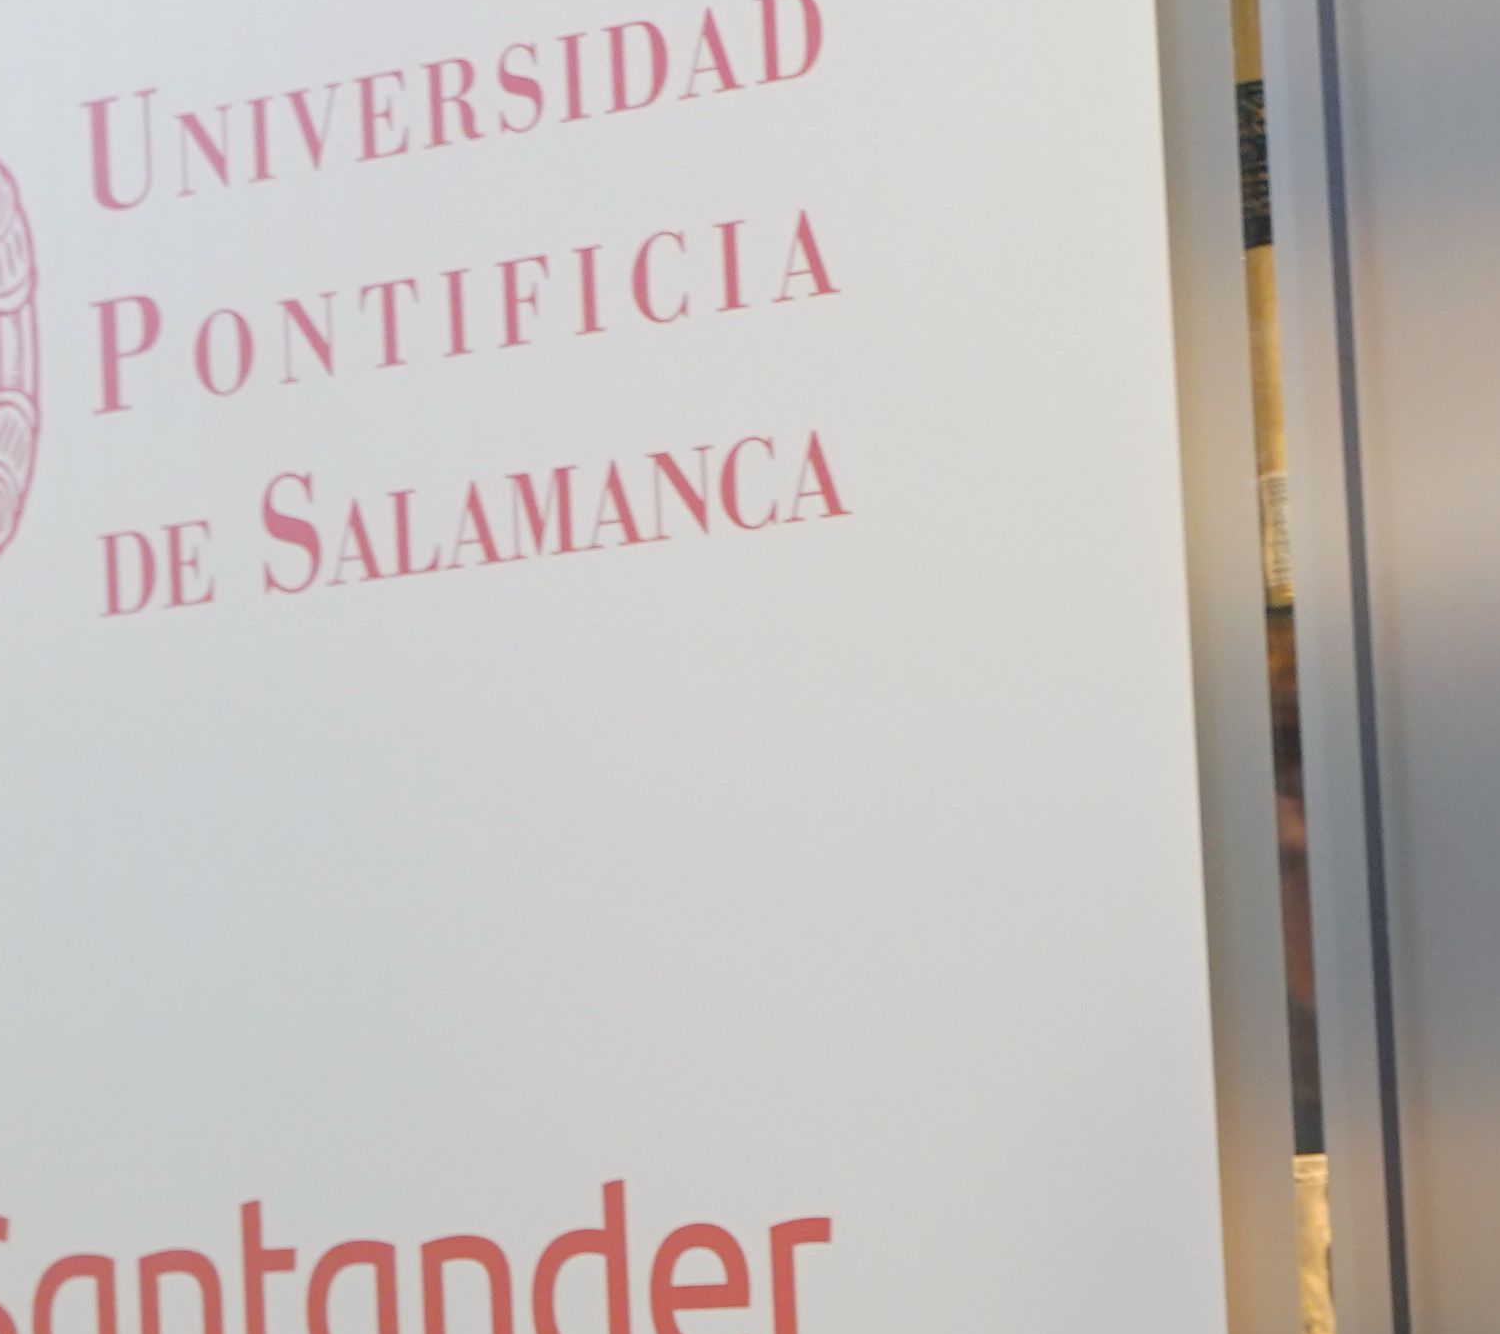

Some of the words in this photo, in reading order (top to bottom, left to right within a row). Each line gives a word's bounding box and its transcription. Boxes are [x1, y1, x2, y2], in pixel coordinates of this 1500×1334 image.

[90, 208, 841, 414] PONTIFICIA
[99, 521, 215, 617] DE
[260, 429, 851, 595] SALAMANCA
